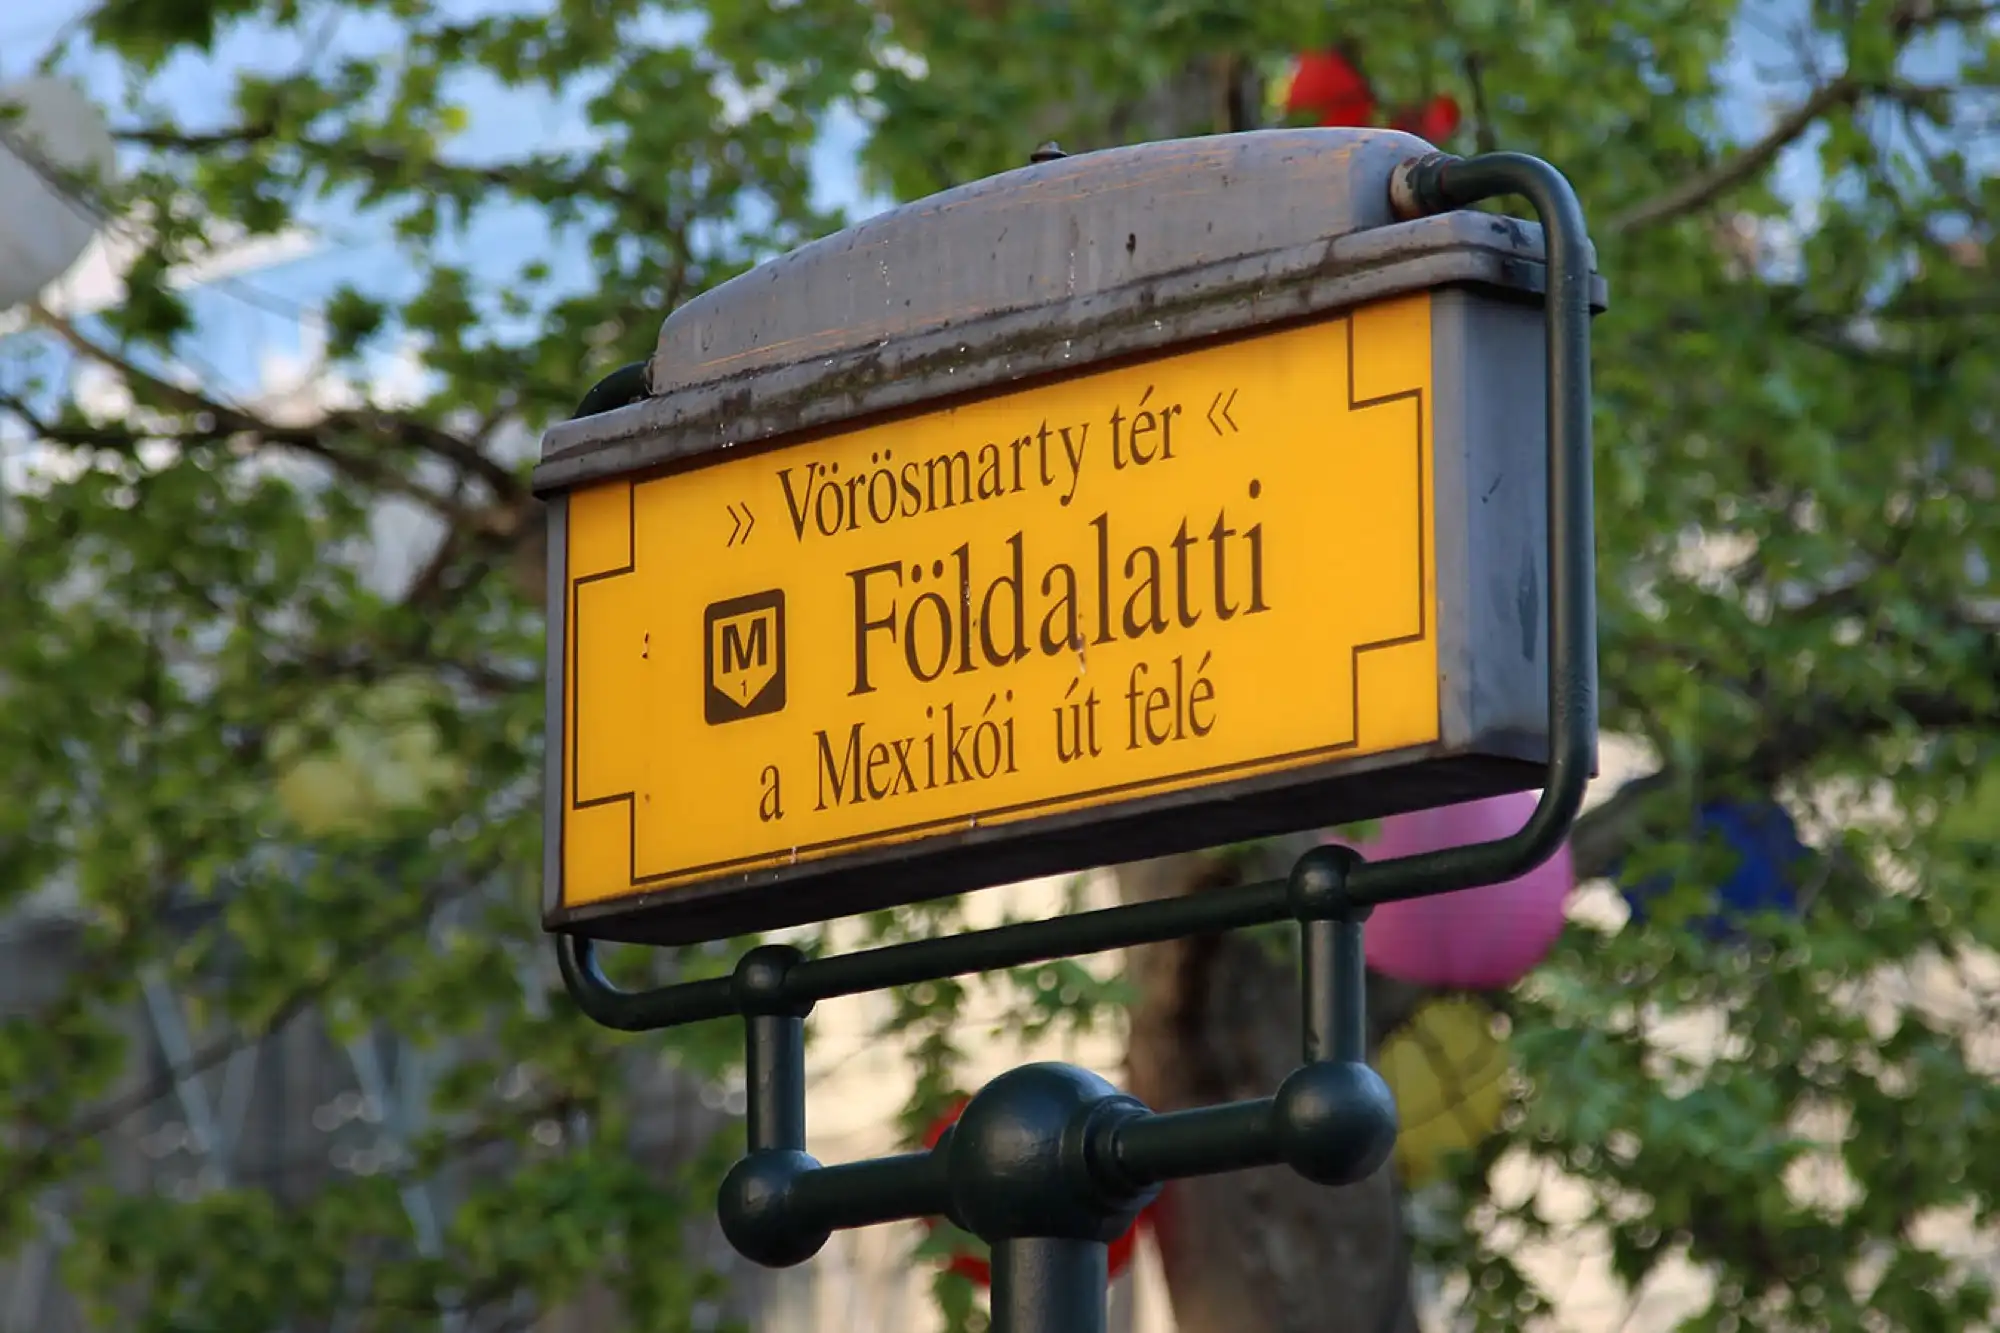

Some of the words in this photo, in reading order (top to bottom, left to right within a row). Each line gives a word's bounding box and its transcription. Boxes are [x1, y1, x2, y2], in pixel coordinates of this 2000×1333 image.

[777, 418, 1091, 543] Vörösmarty
[1110, 384, 1183, 470] tér
[722, 617, 767, 674] M
[845, 479, 1271, 697] Földalatti
[740, 679, 748, 697] 1
[759, 765, 784, 822] a
[813, 689, 1018, 811] Mexikói
[1053, 677, 1101, 765] út
[1124, 650, 1217, 750] felé
